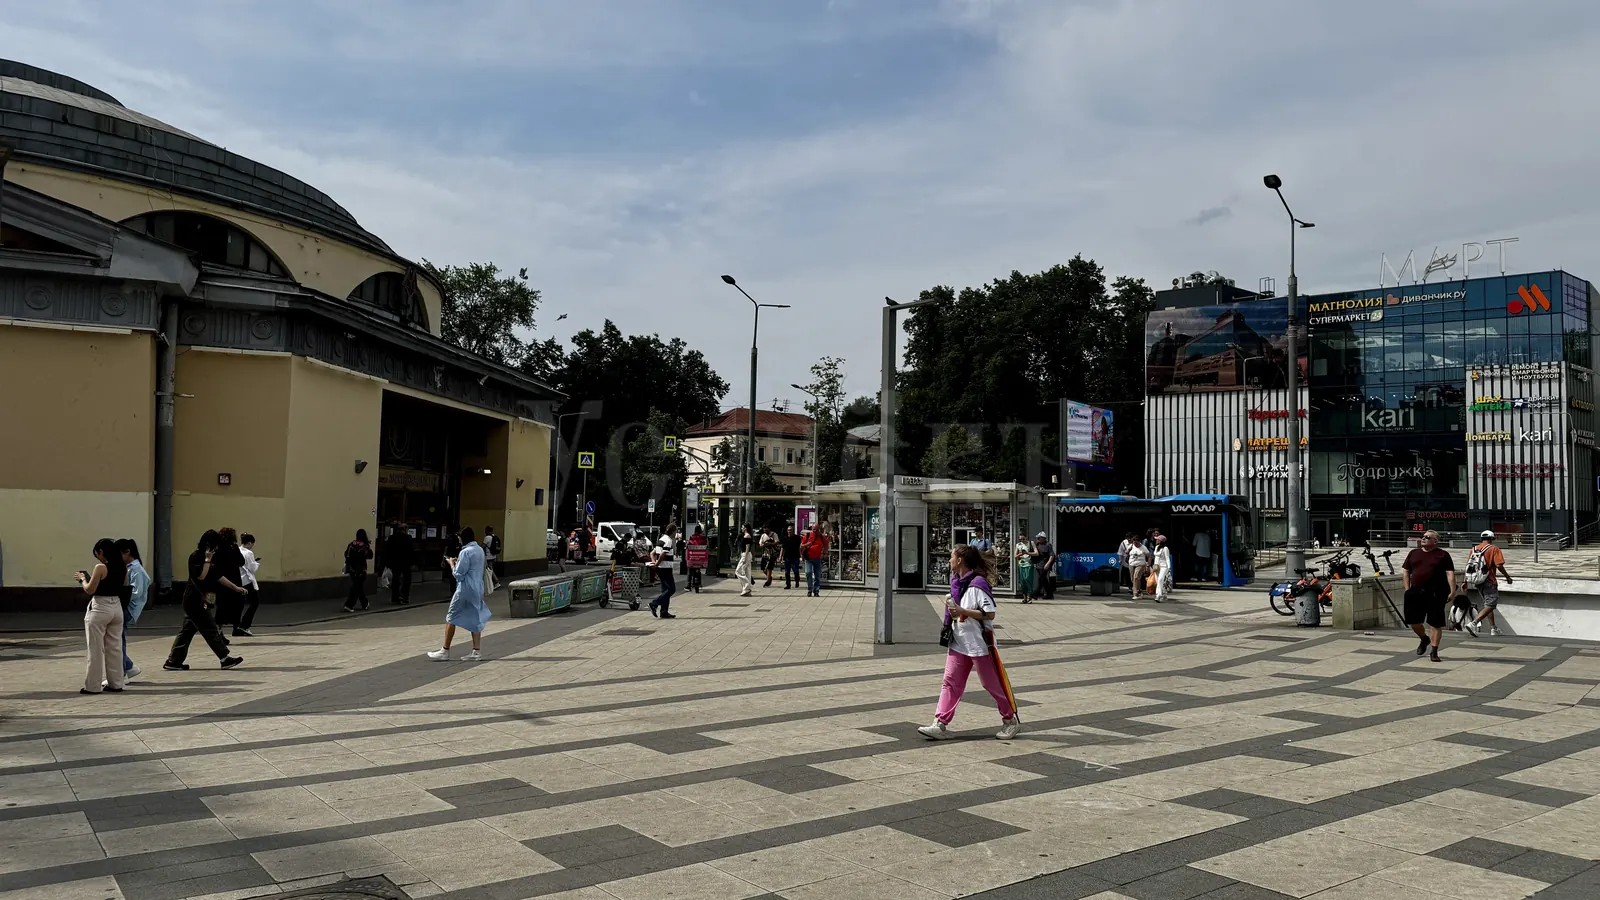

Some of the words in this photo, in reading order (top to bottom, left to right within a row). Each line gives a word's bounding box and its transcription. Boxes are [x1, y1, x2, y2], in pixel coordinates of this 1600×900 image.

[1379, 237, 1519, 286] МАРТ
[1308, 297, 1383, 313] МАГНОЛИЯ
[1308, 313, 1371, 325] СУПЕРМАРКЕТ
[1371, 312, 1382, 320] 24
[1468, 403, 1511, 411] АПТЕКА
[1248, 408, 1308, 421] Теремк
[1361, 402, 1415, 428] kari
[1247, 436, 1309, 446] АТРЕША
[1519, 427, 1552, 442] kari
[1337, 462, 1435, 481] Подружка
[1342, 510, 1370, 519] МАРТ
[1417, 511, 1468, 519] ФОРАБАНК
